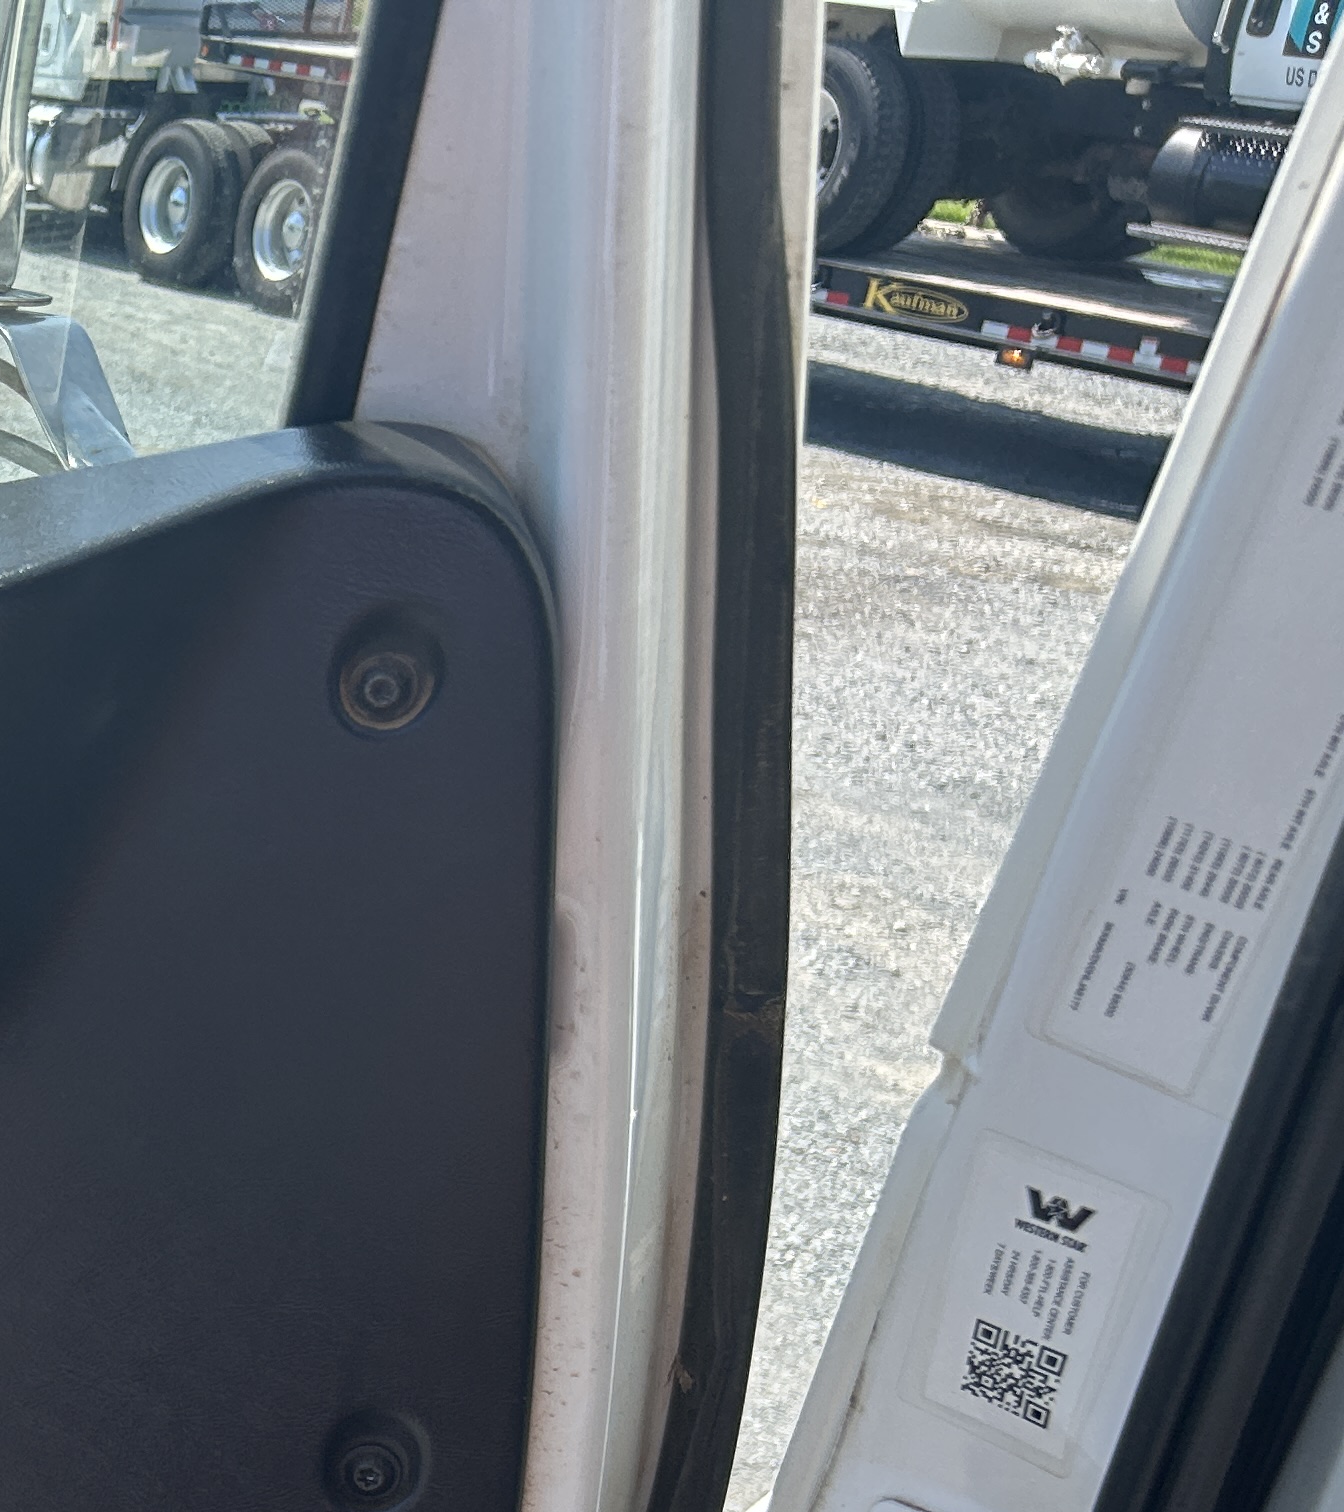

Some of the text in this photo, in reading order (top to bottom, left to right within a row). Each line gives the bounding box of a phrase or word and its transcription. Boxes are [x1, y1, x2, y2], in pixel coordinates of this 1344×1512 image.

[1306, 30, 1322, 54] S
[1286, 66, 1304, 87] US
[863, 276, 959, 319] Kaufman
[1015, 1218, 1059, 1243] WESTERN
[1063, 1271, 1091, 1335] FOR CUSTOMER
[1041, 1307, 1059, 1341] CENTER
